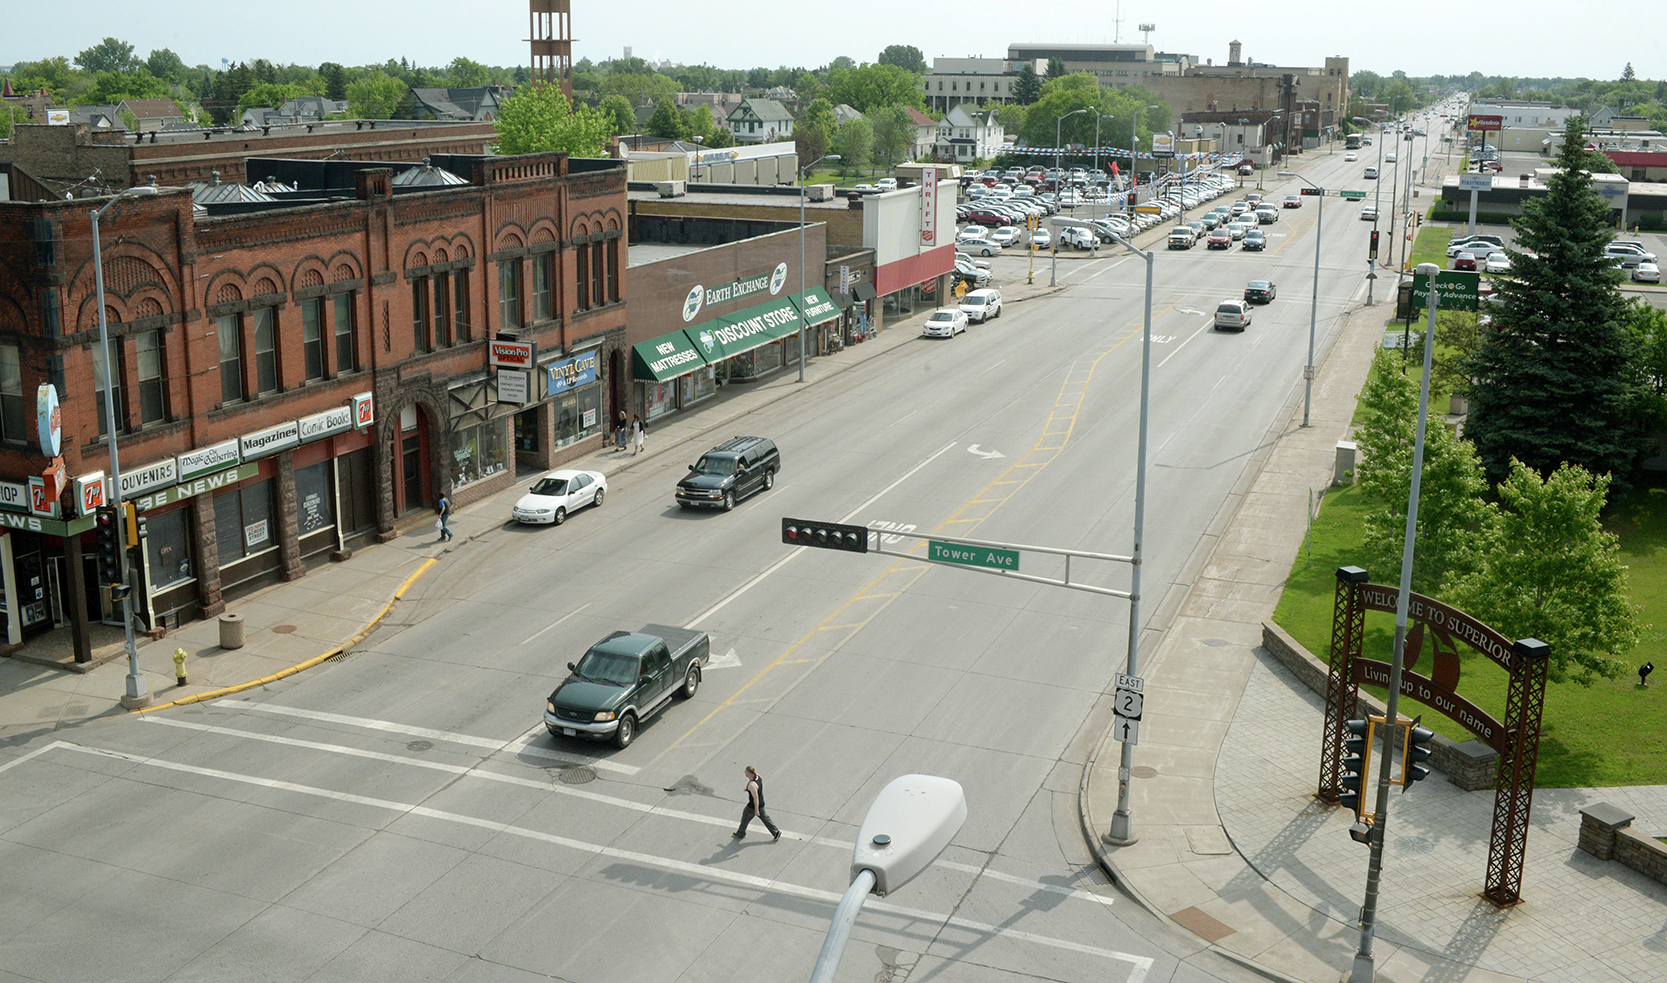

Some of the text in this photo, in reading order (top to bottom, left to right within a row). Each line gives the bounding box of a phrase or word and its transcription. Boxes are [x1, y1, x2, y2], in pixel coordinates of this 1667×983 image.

[706, 286, 731, 305] EARTH
[732, 276, 768, 297] EXCHANGE
[1425, 281, 1448, 290] Ceck
[805, 294, 820, 305] NEW
[805, 301, 834, 319] FURNITURE
[714, 306, 798, 345] DISCOUNT STORE
[498, 355, 524, 363] OPTICAL
[656, 341, 675, 356] NEW
[549, 357, 595, 380] VINYL CAVE
[650, 349, 698, 373] MATTRESSES
[301, 412, 350, 436] Comic Books
[243, 427, 297, 450] Magazines
[182, 454, 203, 466] Magic
[203, 449, 238, 466] Gathering
[119, 463, 173, 491] OUVENIRS
[177, 470, 238, 499] NEWS
[934, 545, 1013, 566] Tower Ave
[1427, 606, 1445, 625] TO
[1447, 617, 1512, 667] SUPERIOR
[1119, 675, 1140, 688] EAST
[1124, 696, 1133, 712] 2
[1364, 666, 1492, 738] Livin up to our name
